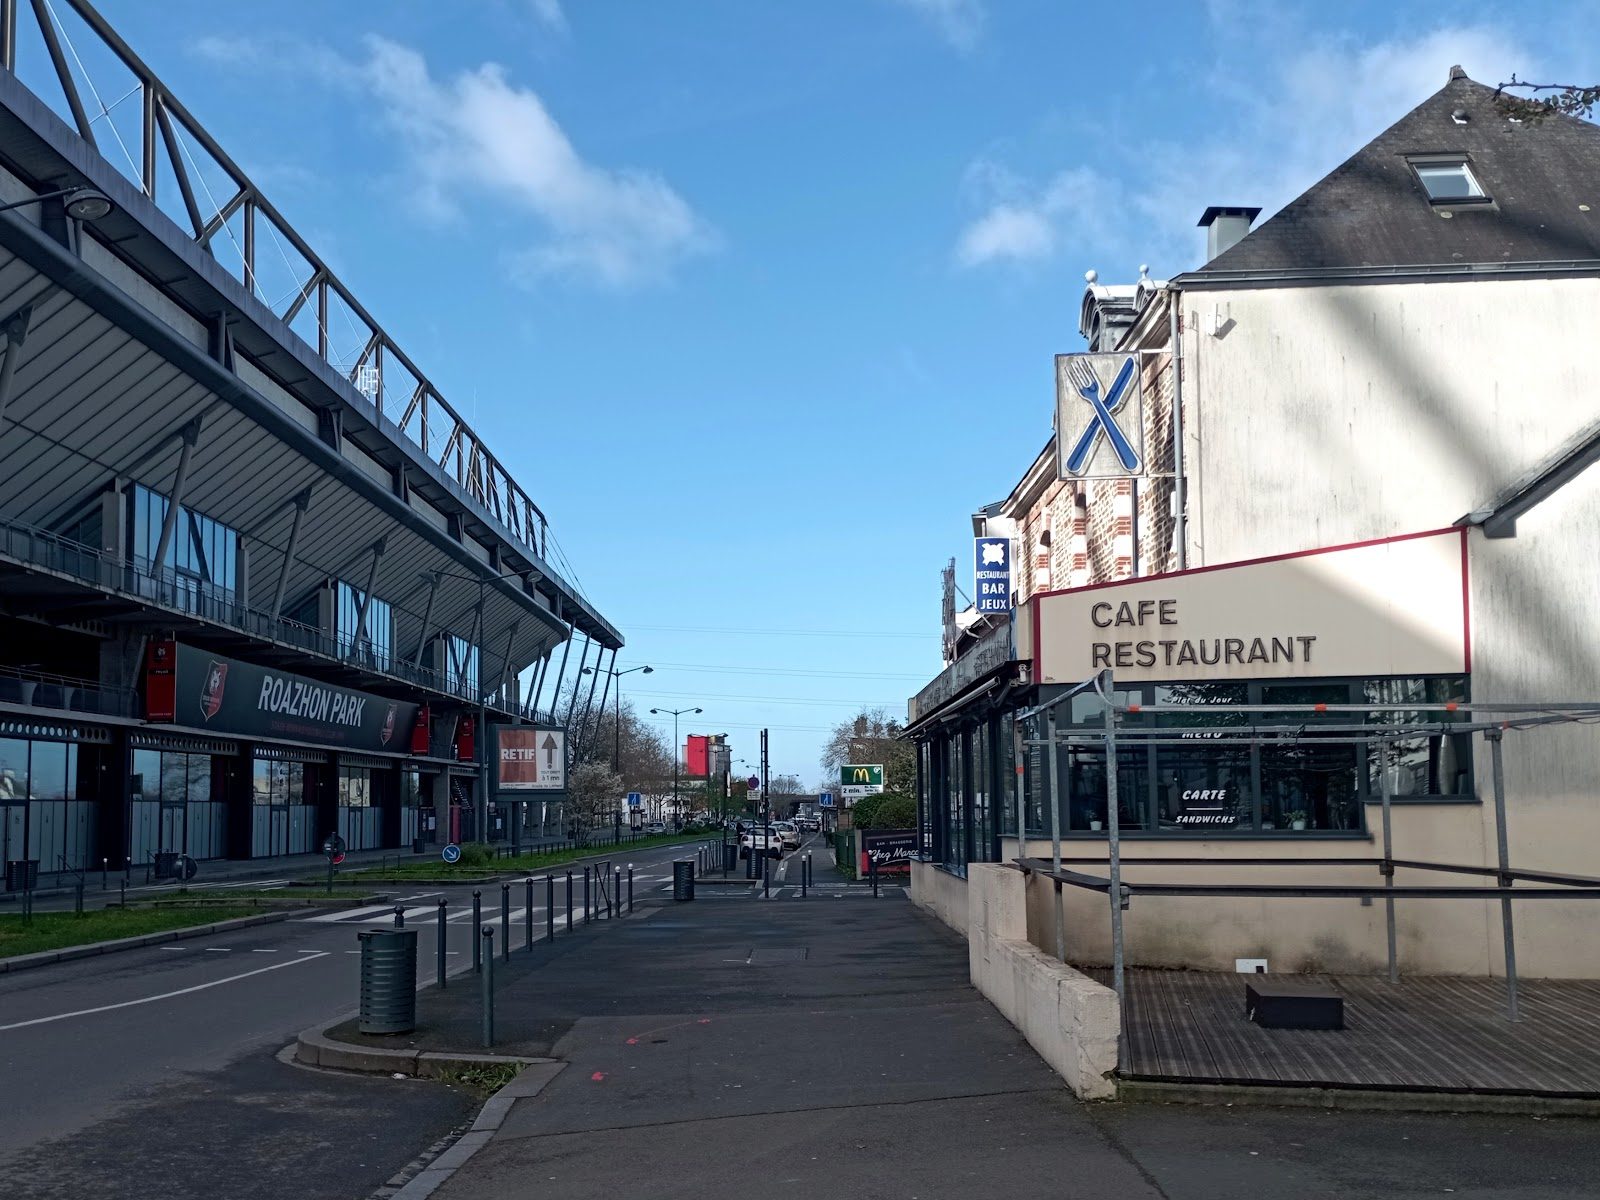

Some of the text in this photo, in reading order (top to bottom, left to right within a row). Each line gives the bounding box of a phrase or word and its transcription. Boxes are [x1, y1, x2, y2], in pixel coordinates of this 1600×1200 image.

[977, 570, 1010, 579] RESTAURANT
[982, 583, 1005, 595] BAR
[980, 599, 1007, 610] JEUX
[1091, 599, 1178, 628] CAFE
[1092, 635, 1317, 668] RESTAURANT
[258, 675, 366, 727] ROAZHON PARK
[1171, 696, 1233, 704] Plat du Jour
[500, 748, 535, 760] RETIF
[1182, 790, 1226, 800] CARTE
[1175, 815, 1236, 824] SANDWICHS
